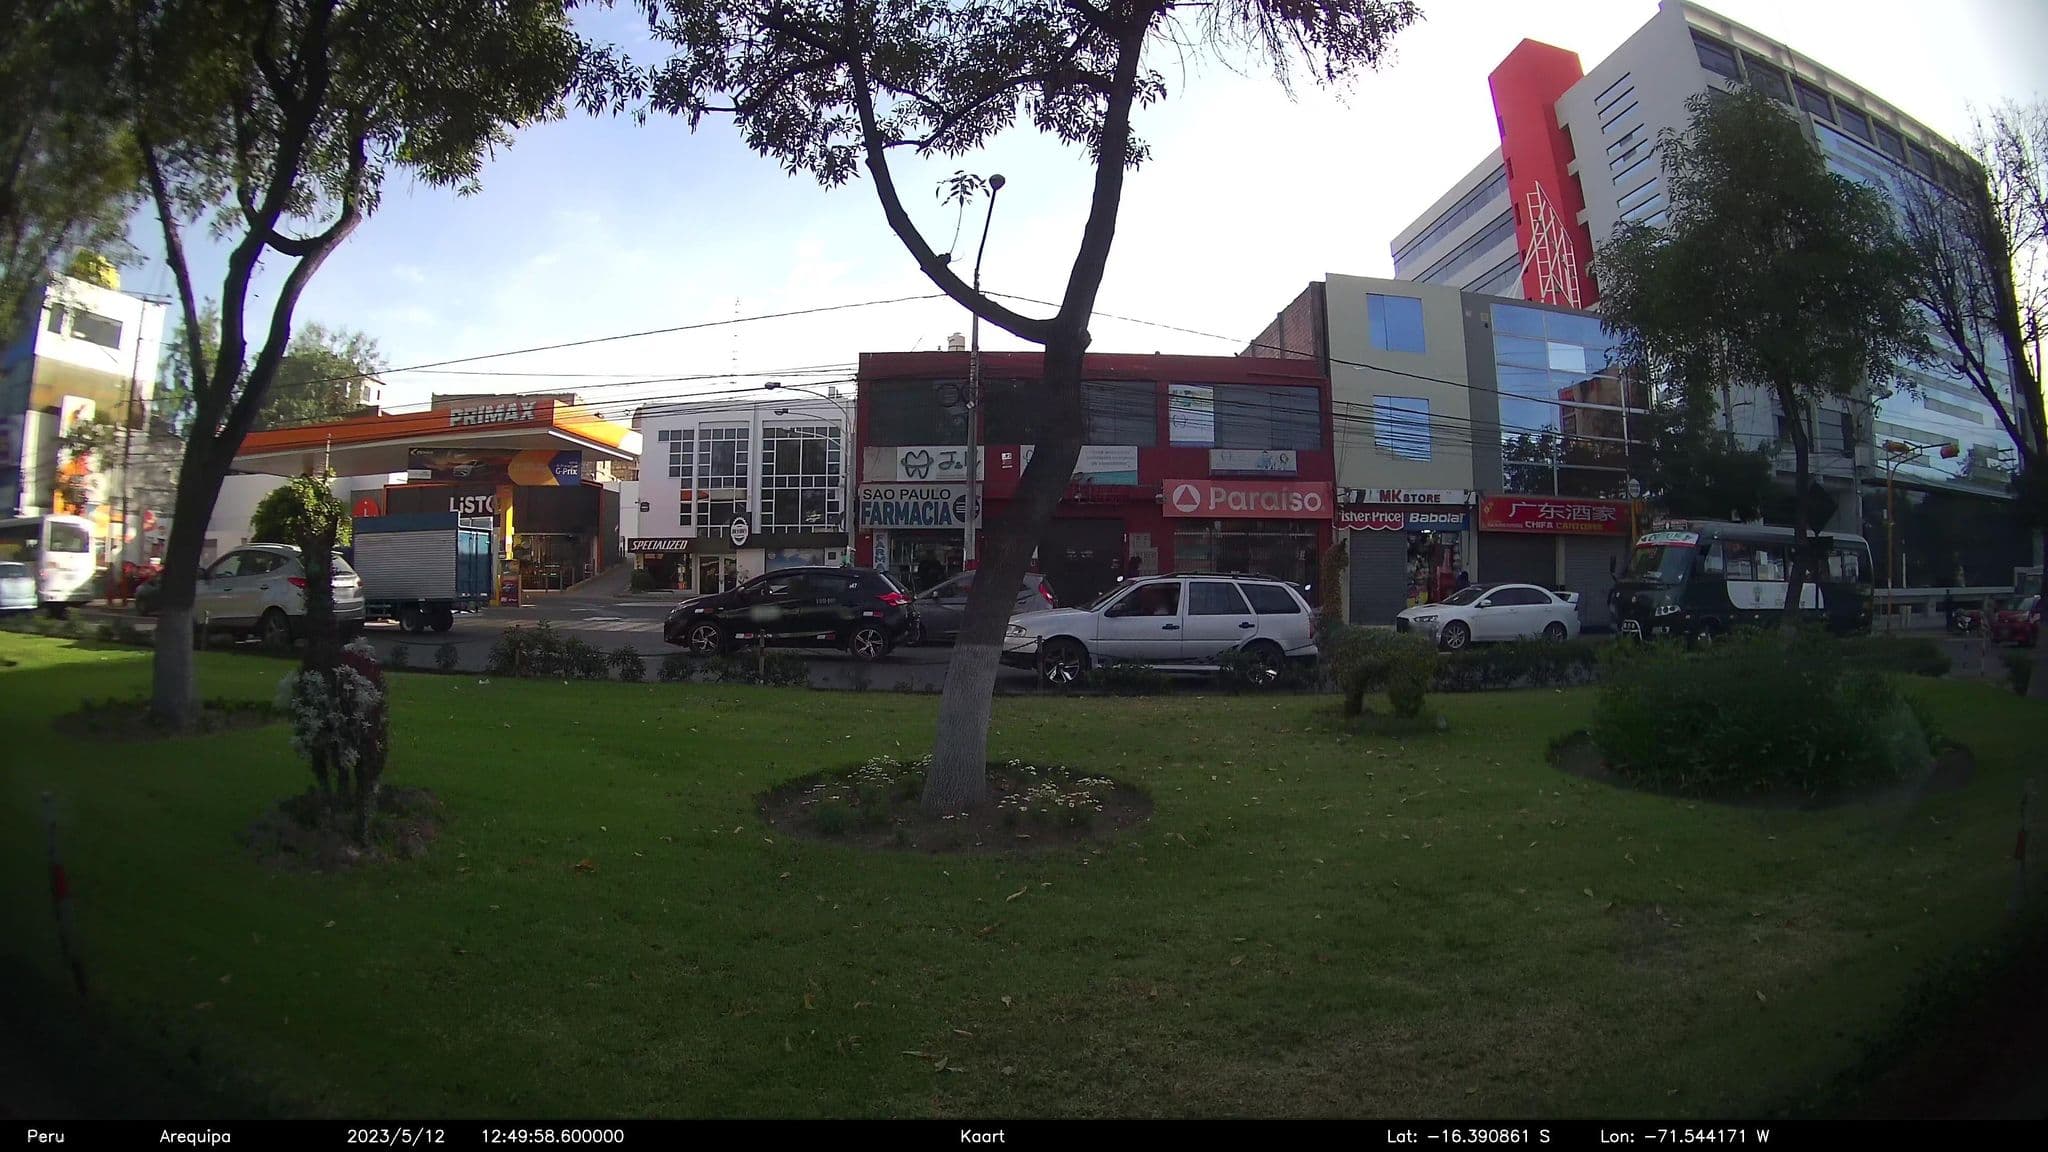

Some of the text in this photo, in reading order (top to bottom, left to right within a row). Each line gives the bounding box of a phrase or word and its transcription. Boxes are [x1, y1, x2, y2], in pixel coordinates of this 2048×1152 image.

[450, 402, 535, 426] PRIMAX
[555, 467, 578, 475] G-Prix
[863, 488, 951, 500] SAO PAULO
[1379, 490, 1441, 503] MK STORE
[861, 501, 952, 525] FARMACIA
[1508, 501, 1617, 522] 广东酒家
[1525, 520, 1554, 529] CHIFA
[631, 539, 688, 550] SPECIALIZED
